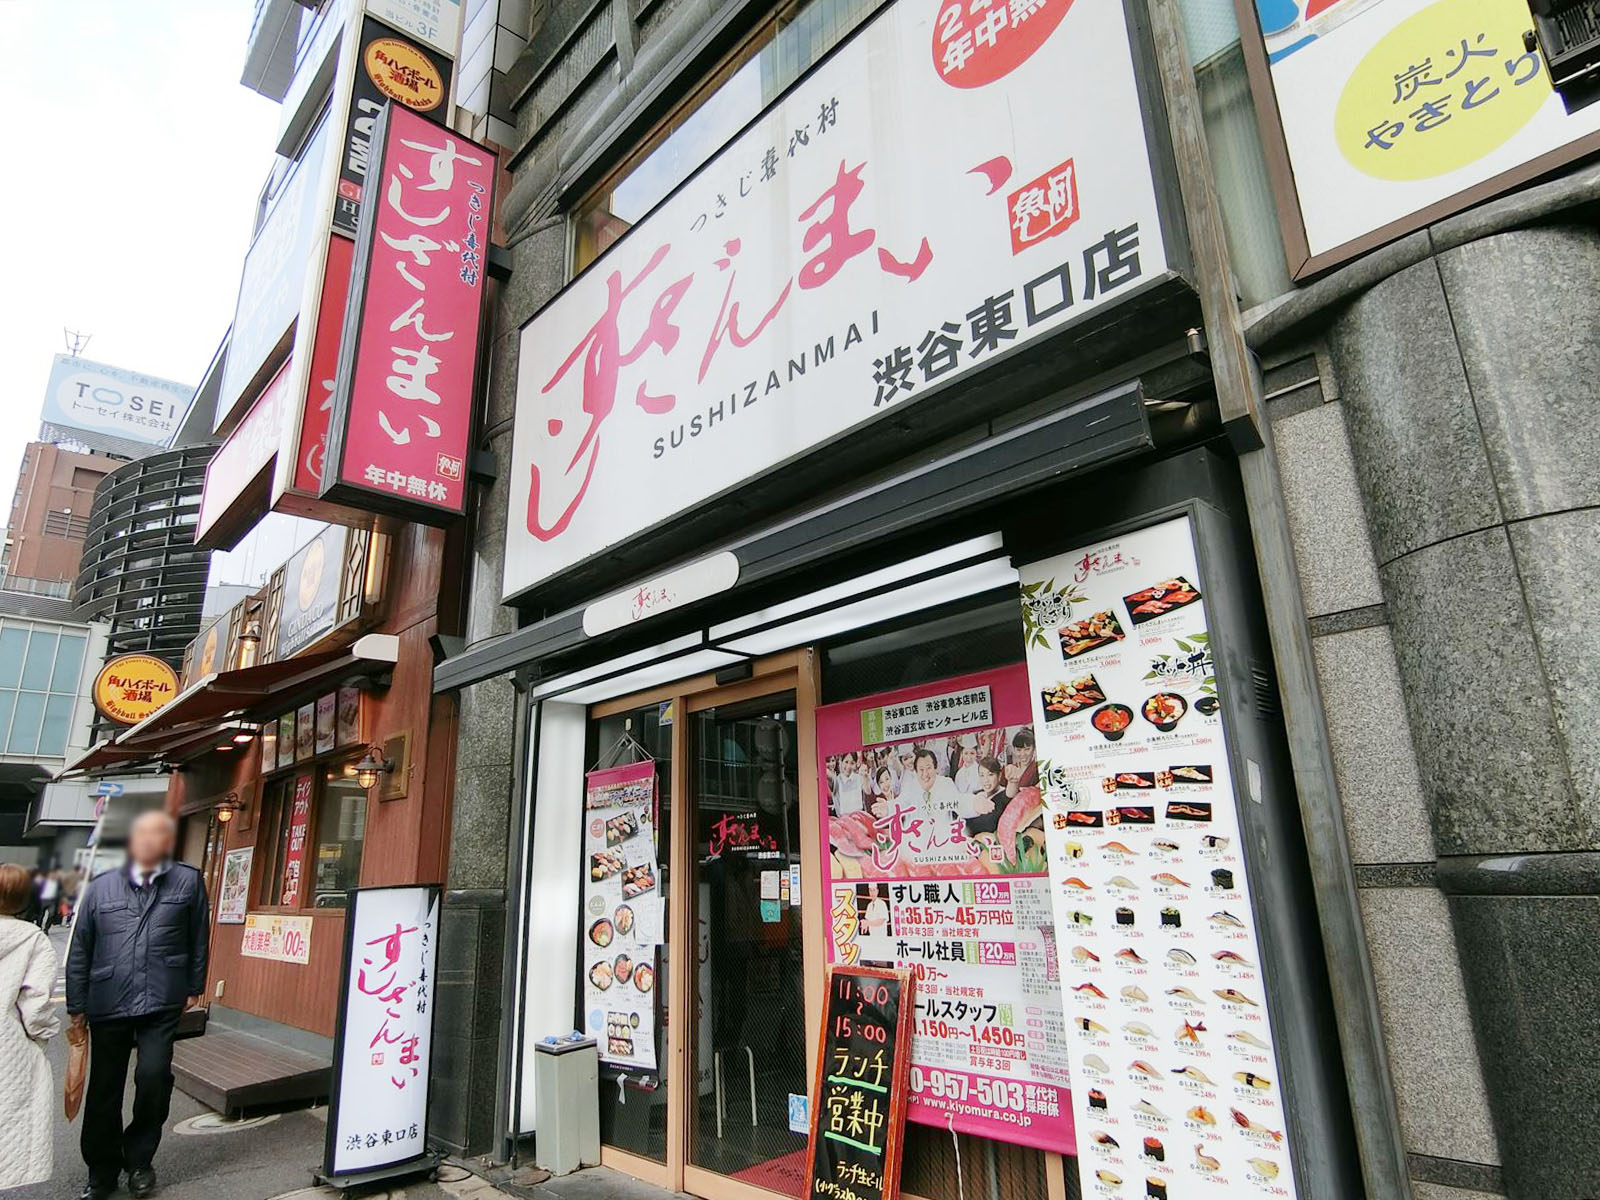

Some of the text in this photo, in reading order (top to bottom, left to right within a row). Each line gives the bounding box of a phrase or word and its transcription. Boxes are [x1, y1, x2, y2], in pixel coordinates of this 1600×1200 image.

[416, 21, 438, 39] 3F
[374, 49, 438, 91] 角ハイボール
[388, 70, 419, 94] 酒場
[1393, 33, 1498, 104] 炭火
[1364, 52, 1540, 151] やきとり
[690, 97, 839, 232] つきじ喜代村
[460, 181, 486, 287] つきじ喜代村
[379, 139, 483, 446] すしざんまい
[872, 222, 1142, 407] 渋谷東口店
[526, 155, 1013, 542] すしざんまい
[74, 382, 175, 420] TOSEI
[653, 310, 879, 460] SUSHIZANMAI
[72, 400, 172, 432] トーセイ株式会社
[364, 464, 448, 502] 年中無休
[107, 674, 172, 693] 角ハイボール
[122, 688, 152, 703] 酒場
[884, 704, 919, 720] 渋谷東口店
[886, 709, 989, 737] 渋谷道玄坂センタービル店
[290, 838, 304, 852] OUT
[291, 823, 306, 838] TAKE
[871, 803, 992, 871] すしざんまい
[914, 855, 969, 864] SUSHIZANMAI
[892, 883, 960, 904] すし職人
[897, 940, 966, 962] ホール社員
[416, 922, 432, 1014] つきじ喜代村
[358, 923, 420, 1090] すしざんまい
[833, 1047, 889, 1087] ランチ
[970, 1056, 1011, 1072] 賞与年3回
[1025, 1100, 1060, 1118] 採用係
[1026, 1084, 1058, 1102] 喜代村
[827, 1086, 884, 1148] 営業中
[923, 1096, 1032, 1128] www.kiyomura.co.jp
[346, 1122, 418, 1151] 渋谷東口店
